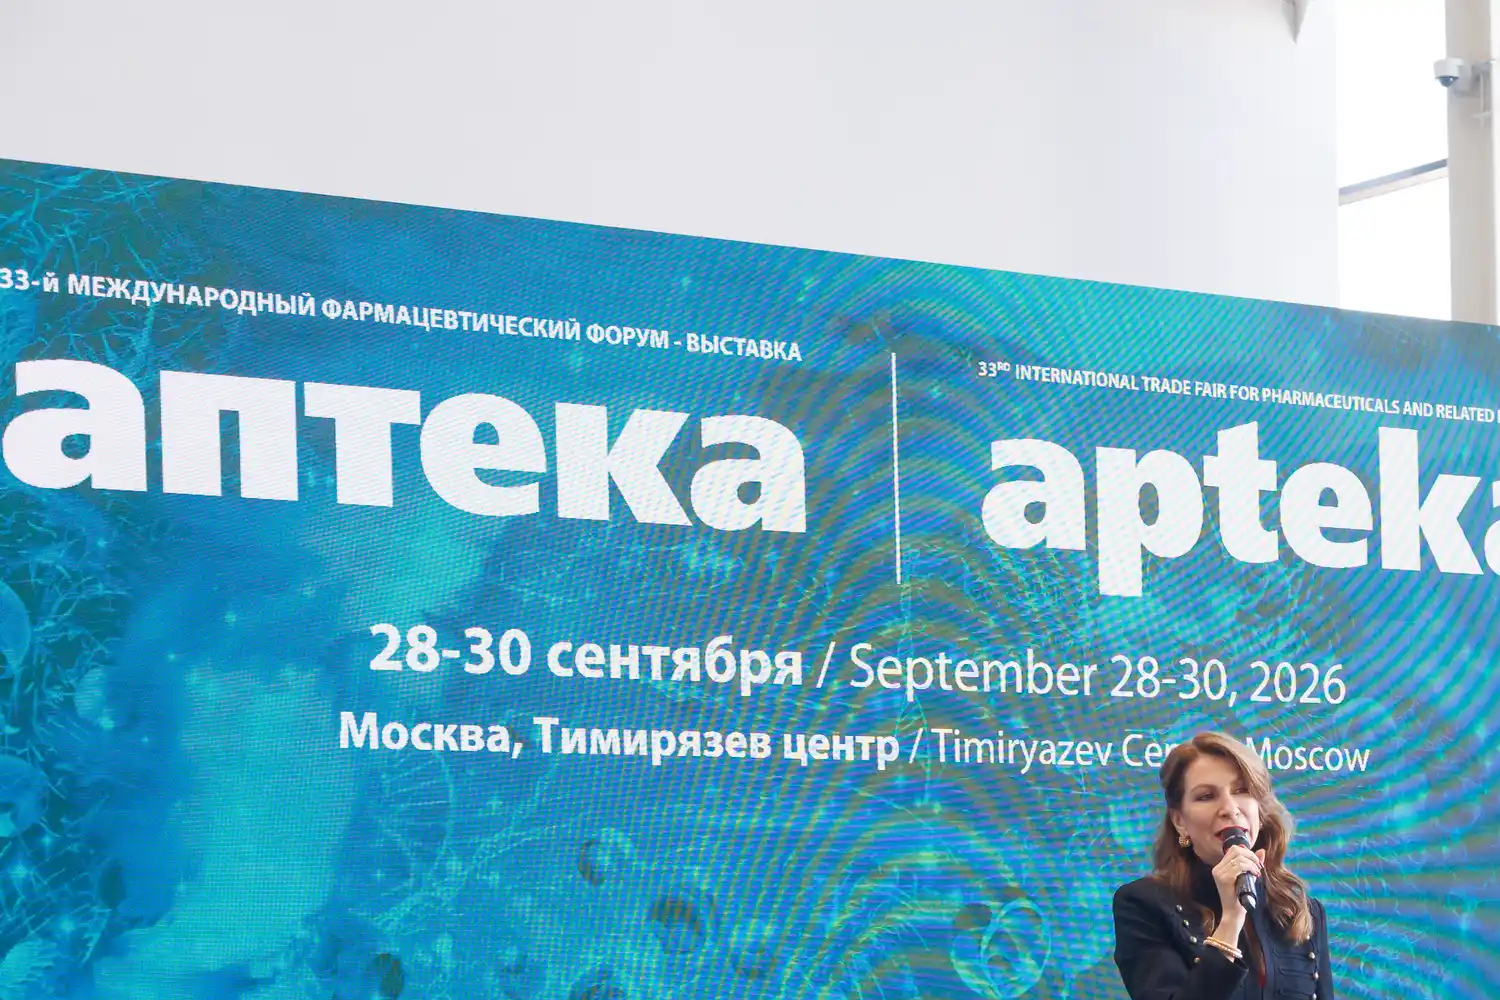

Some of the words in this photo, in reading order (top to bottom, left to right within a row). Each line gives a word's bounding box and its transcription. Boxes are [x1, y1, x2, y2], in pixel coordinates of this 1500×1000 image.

[0, 267, 59, 293] 33-й
[68, 274, 316, 317] МЕЖДУНАРОДНЫЙ
[322, 299, 581, 341] ФАРМАЦЕВТИЧЕСКИЙ
[586, 323, 669, 350] ФОРУМ
[686, 333, 803, 362] ВЫСТАВКА
[1015, 364, 1139, 391] INTERNATIONAL
[1141, 376, 1191, 396] TRADE
[1195, 381, 1227, 399] FAIR
[1229, 385, 1260, 402] FOR
[1262, 387, 1400, 415] PHARMACEUTICALS
[1403, 401, 1433, 418] AND
[1436, 405, 1494, 424] RELATED
[2, 358, 807, 534] аптека
[368, 622, 532, 676] 28-30
[546, 634, 803, 696] сентября
[849, 642, 1098, 702] September
[1109, 654, 1237, 707] 28-30,
[1249, 660, 1347, 705] 2026
[339, 711, 524, 759] Москва,
[533, 717, 771, 765] Тимирязев
[783, 731, 899, 770] центр
[930, 728, 1113, 775] Timiryazev
[1246, 736, 1371, 773] Moscow
